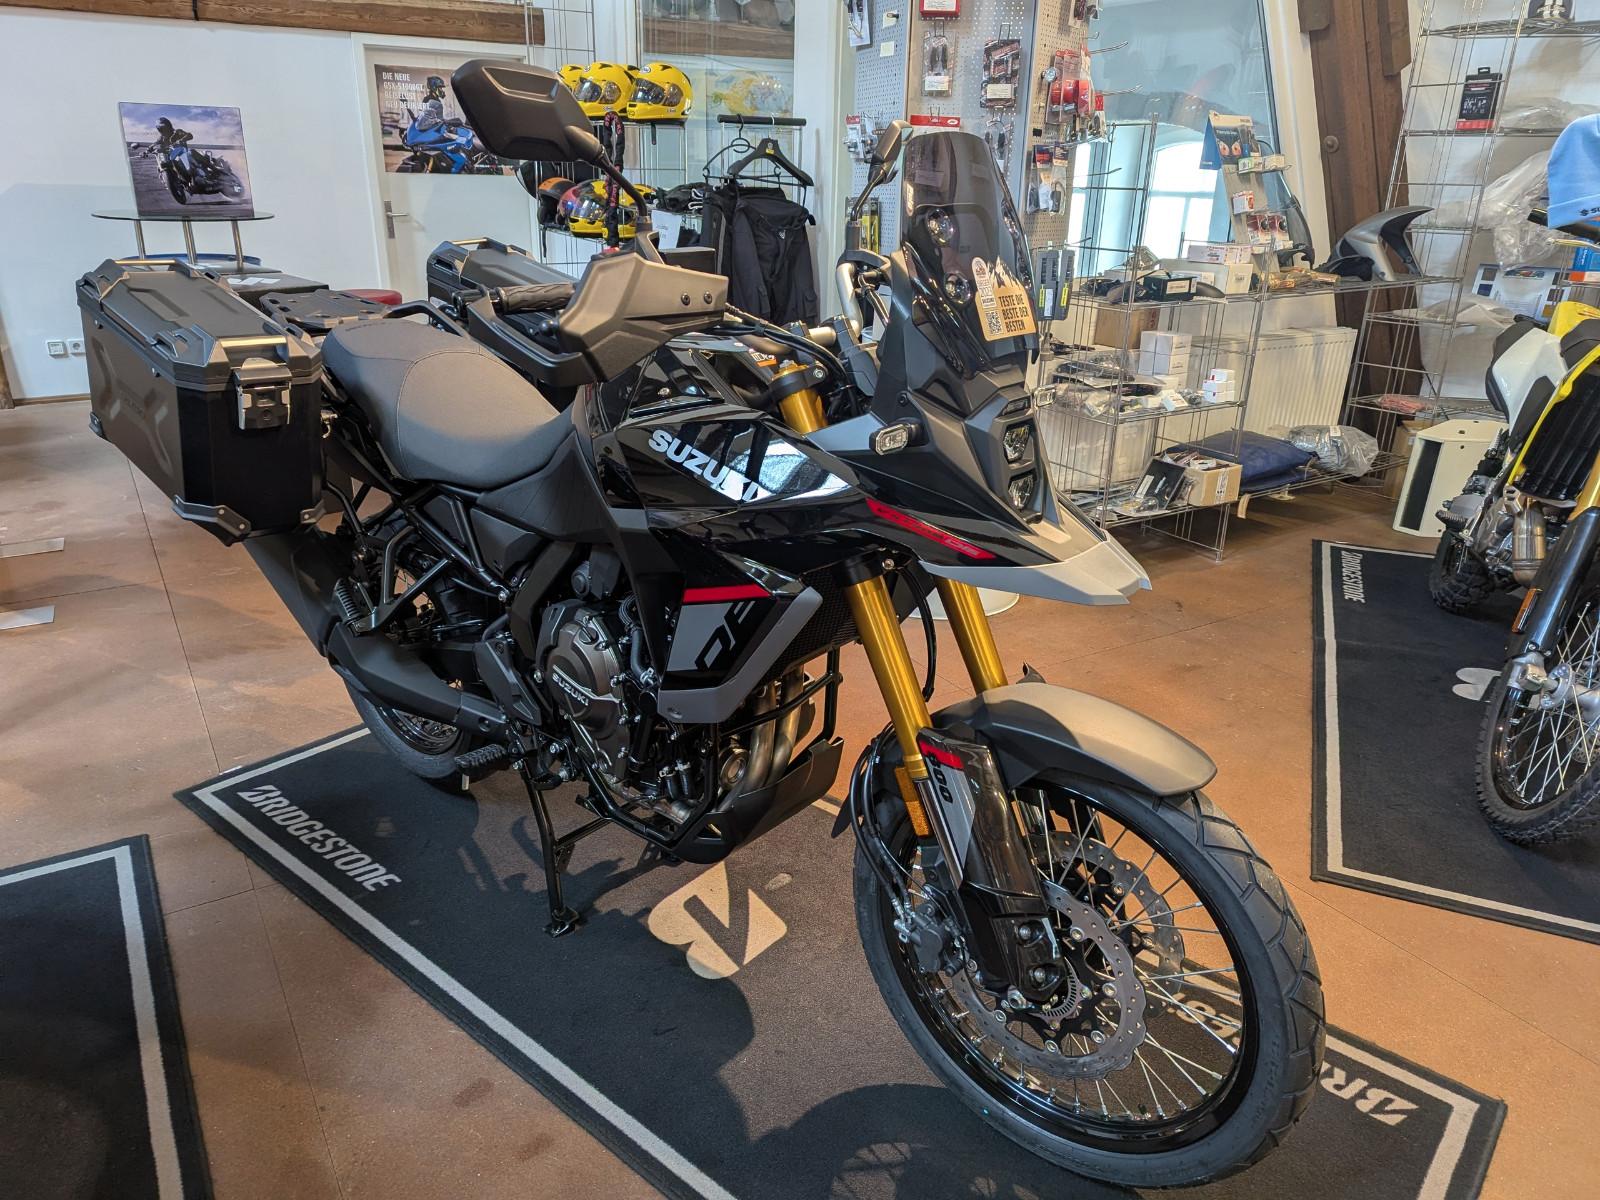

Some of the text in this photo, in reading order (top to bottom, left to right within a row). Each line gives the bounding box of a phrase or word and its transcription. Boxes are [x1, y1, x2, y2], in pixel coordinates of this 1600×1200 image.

[382, 72, 410, 81] DIE NEUE
[998, 295, 1016, 307] TESTE
[1015, 294, 1025, 305] DIE
[1001, 306, 1030, 320] BESTE DER
[1005, 320, 1026, 332] BESTEN
[551, 672, 589, 706] SUZUKI
[236, 784, 402, 892] BRIDGESTONE
